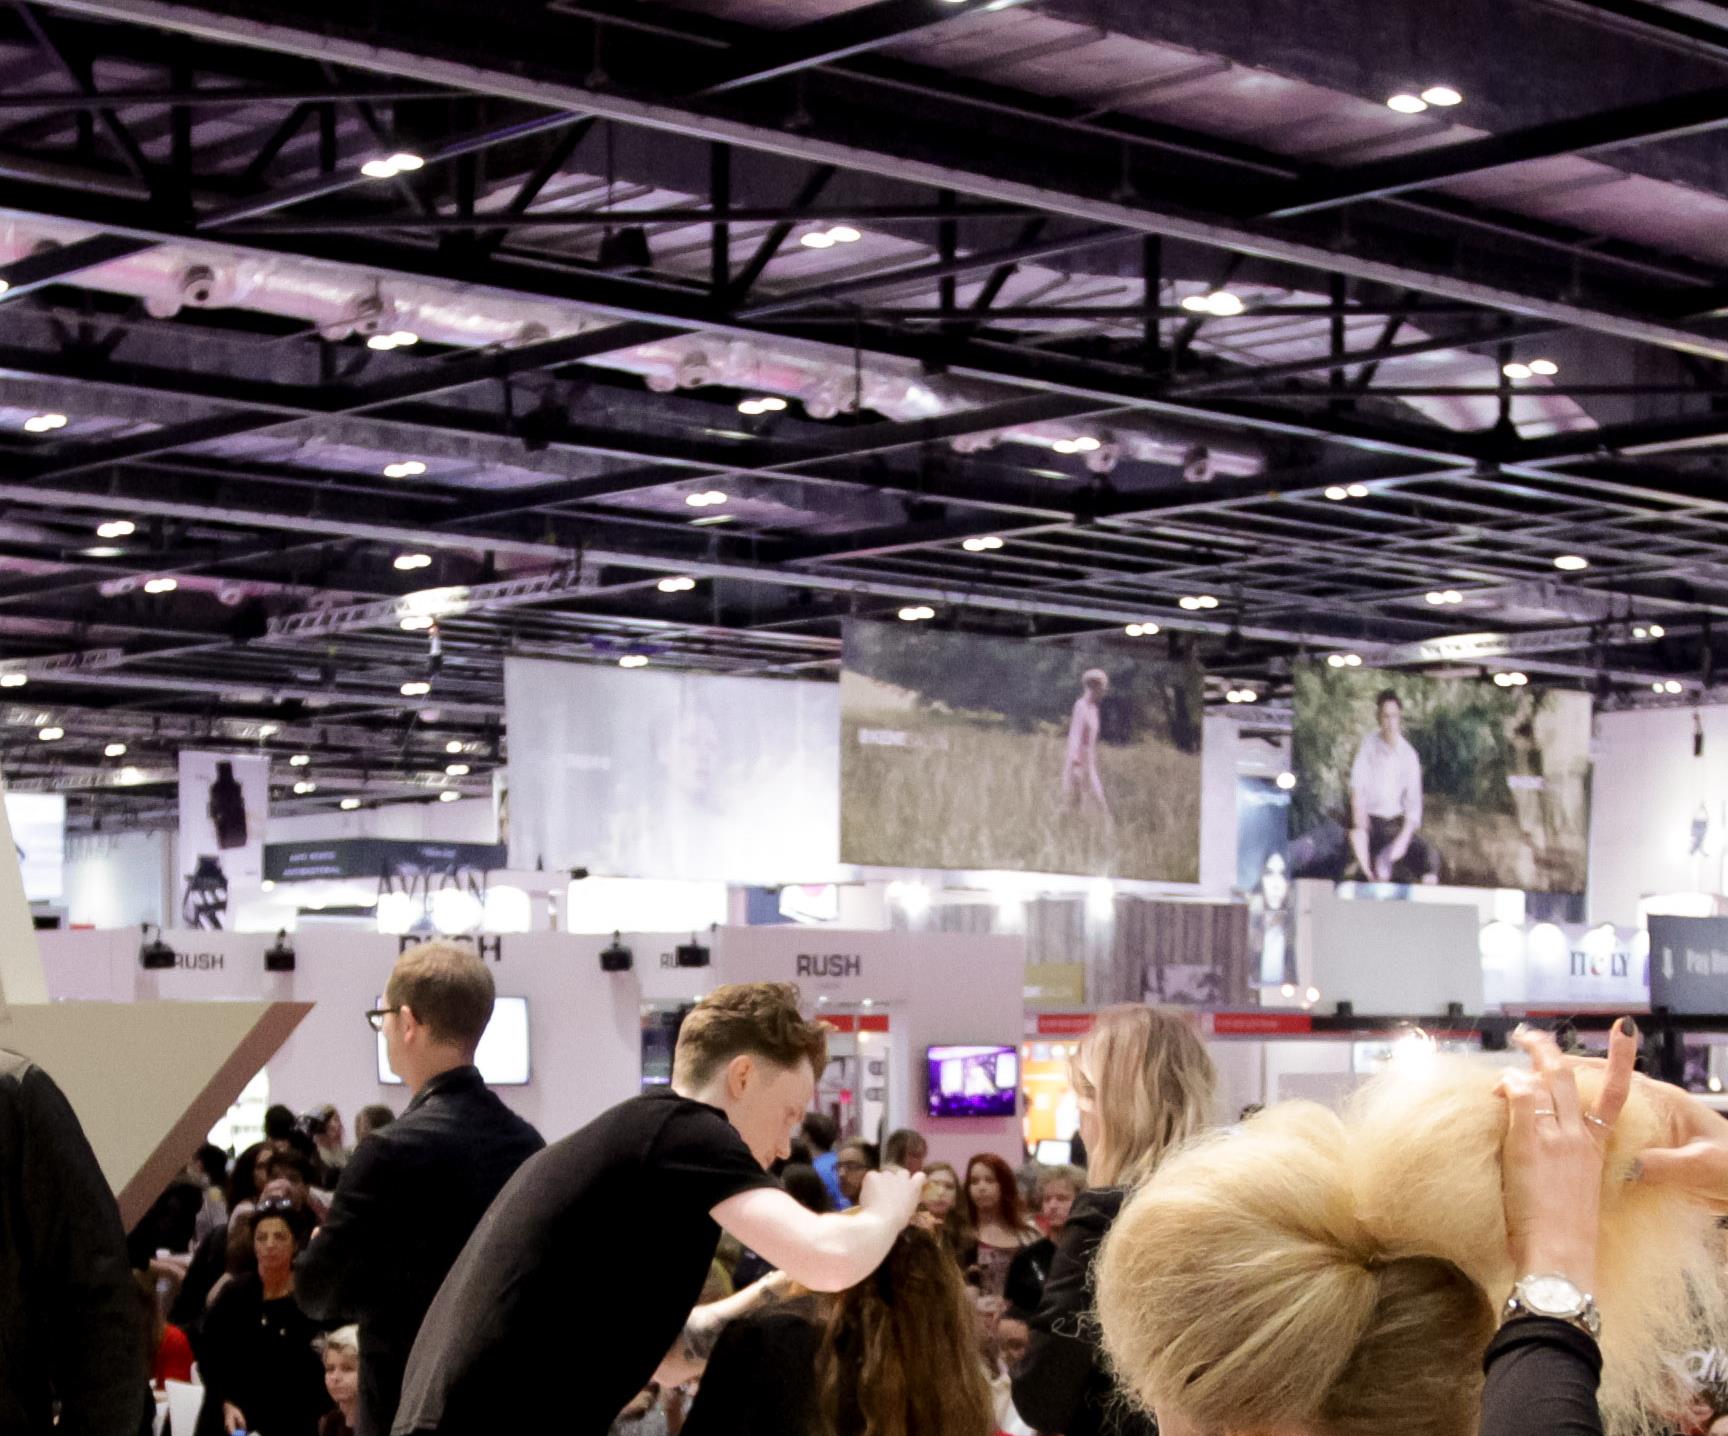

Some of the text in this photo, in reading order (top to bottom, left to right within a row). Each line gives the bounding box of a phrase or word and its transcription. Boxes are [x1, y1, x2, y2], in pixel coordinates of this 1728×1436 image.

[174, 953, 225, 970] RUSH
[795, 954, 862, 977] RUSH
[1571, 951, 1629, 977] ITLY
